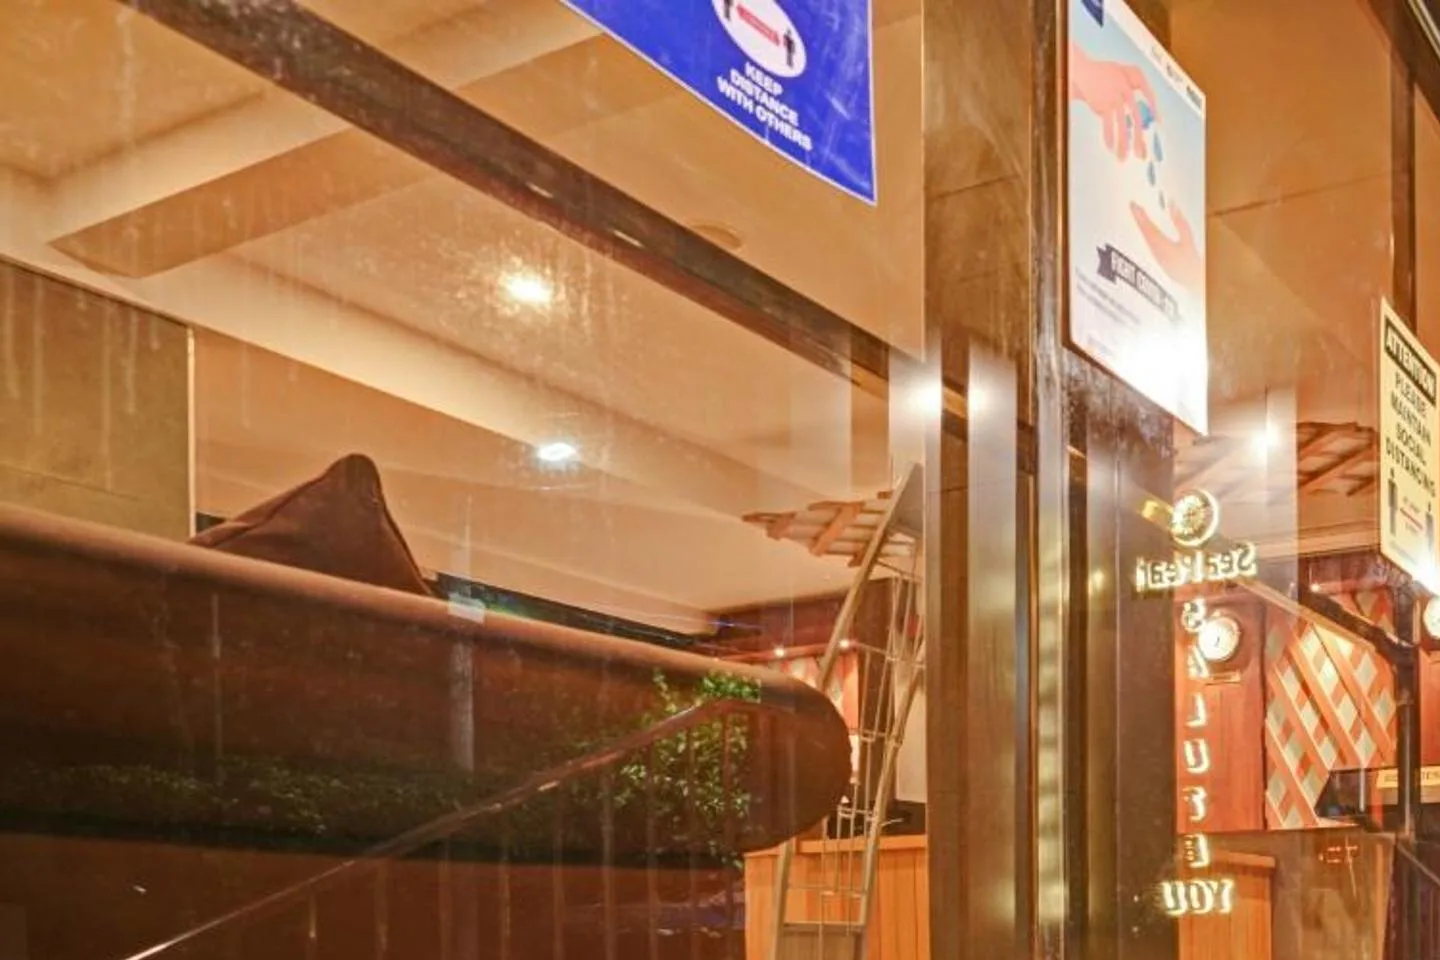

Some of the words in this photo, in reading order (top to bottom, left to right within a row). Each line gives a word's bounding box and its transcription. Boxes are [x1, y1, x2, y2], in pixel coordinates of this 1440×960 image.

[730, 68, 799, 127] DISTANCE
[744, 61, 783, 96] KEEP
[717, 75, 754, 114] WITH
[755, 105, 813, 151] OTHERS
[1385, 436, 1436, 497] DISTANCING
[1396, 421, 1427, 466] SOCIAL
